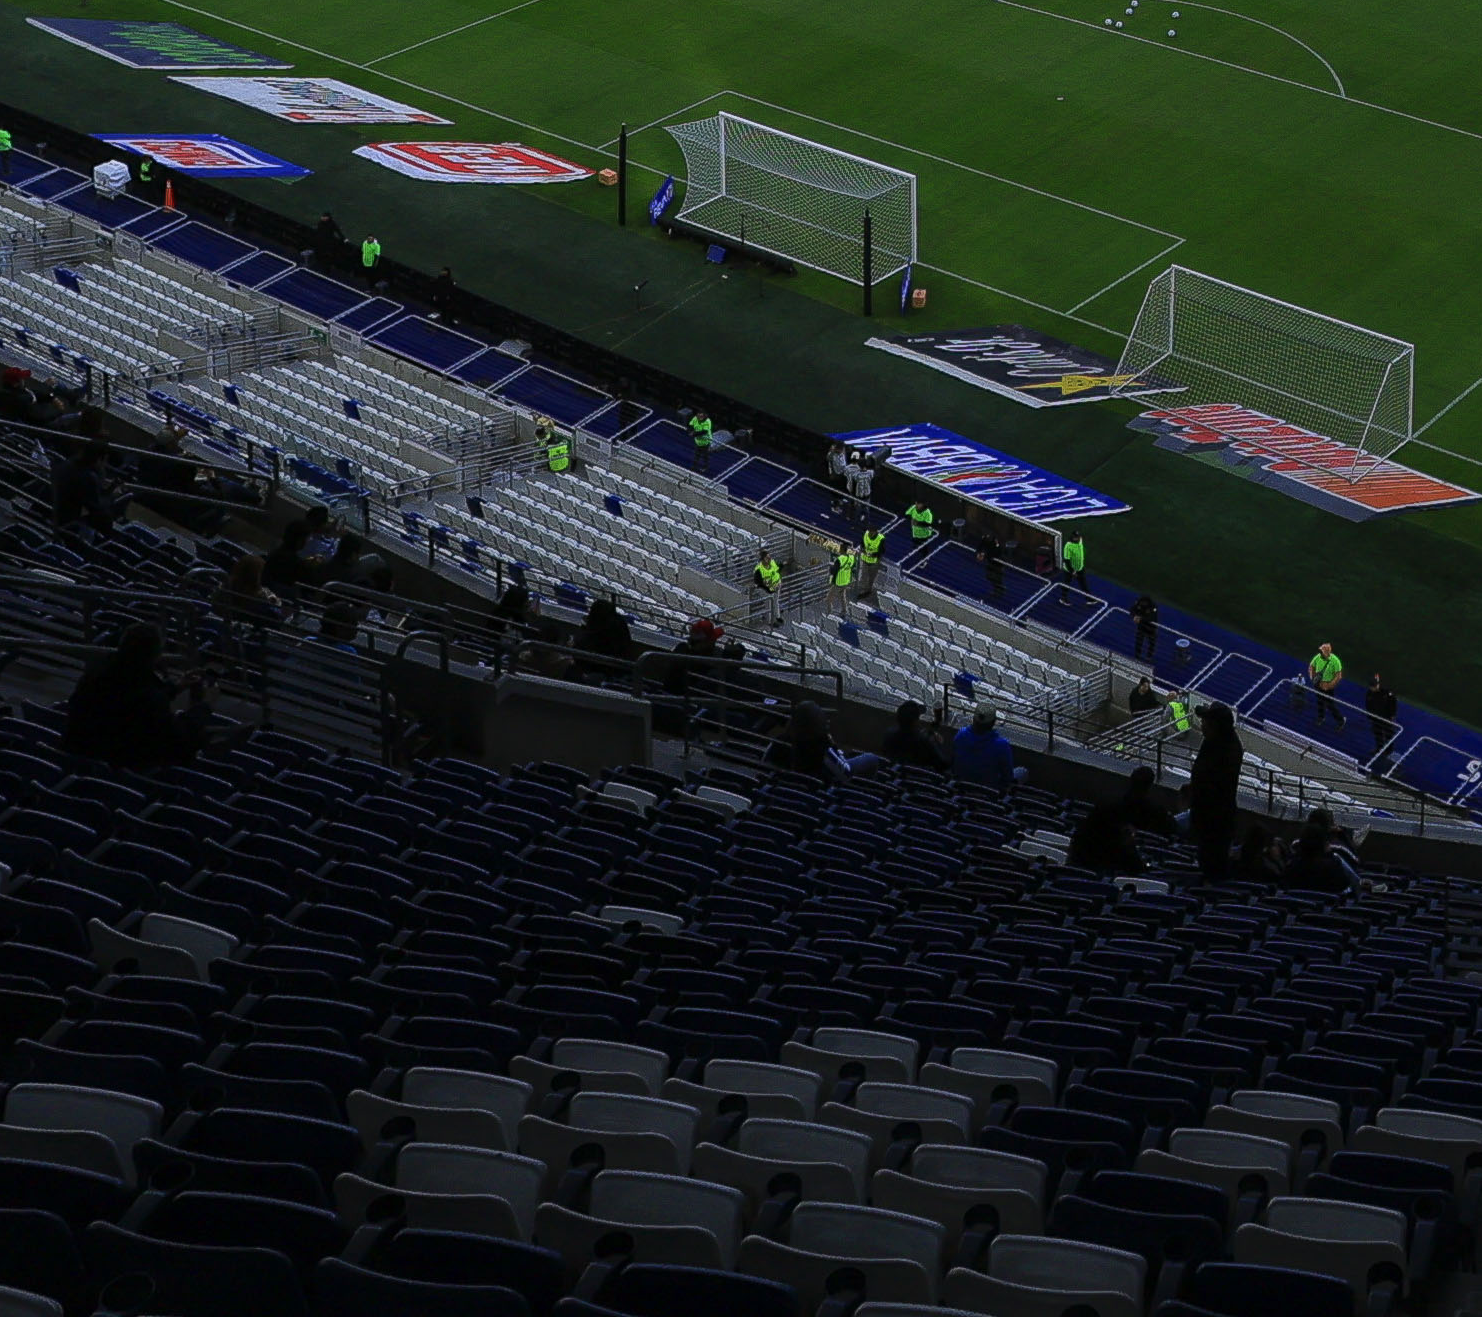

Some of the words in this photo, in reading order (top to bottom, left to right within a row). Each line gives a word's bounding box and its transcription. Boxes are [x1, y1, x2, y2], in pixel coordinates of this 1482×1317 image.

[964, 347, 1104, 379] Carl's
[844, 427, 999, 471] BBVA
[967, 478, 1109, 523] LIGA
